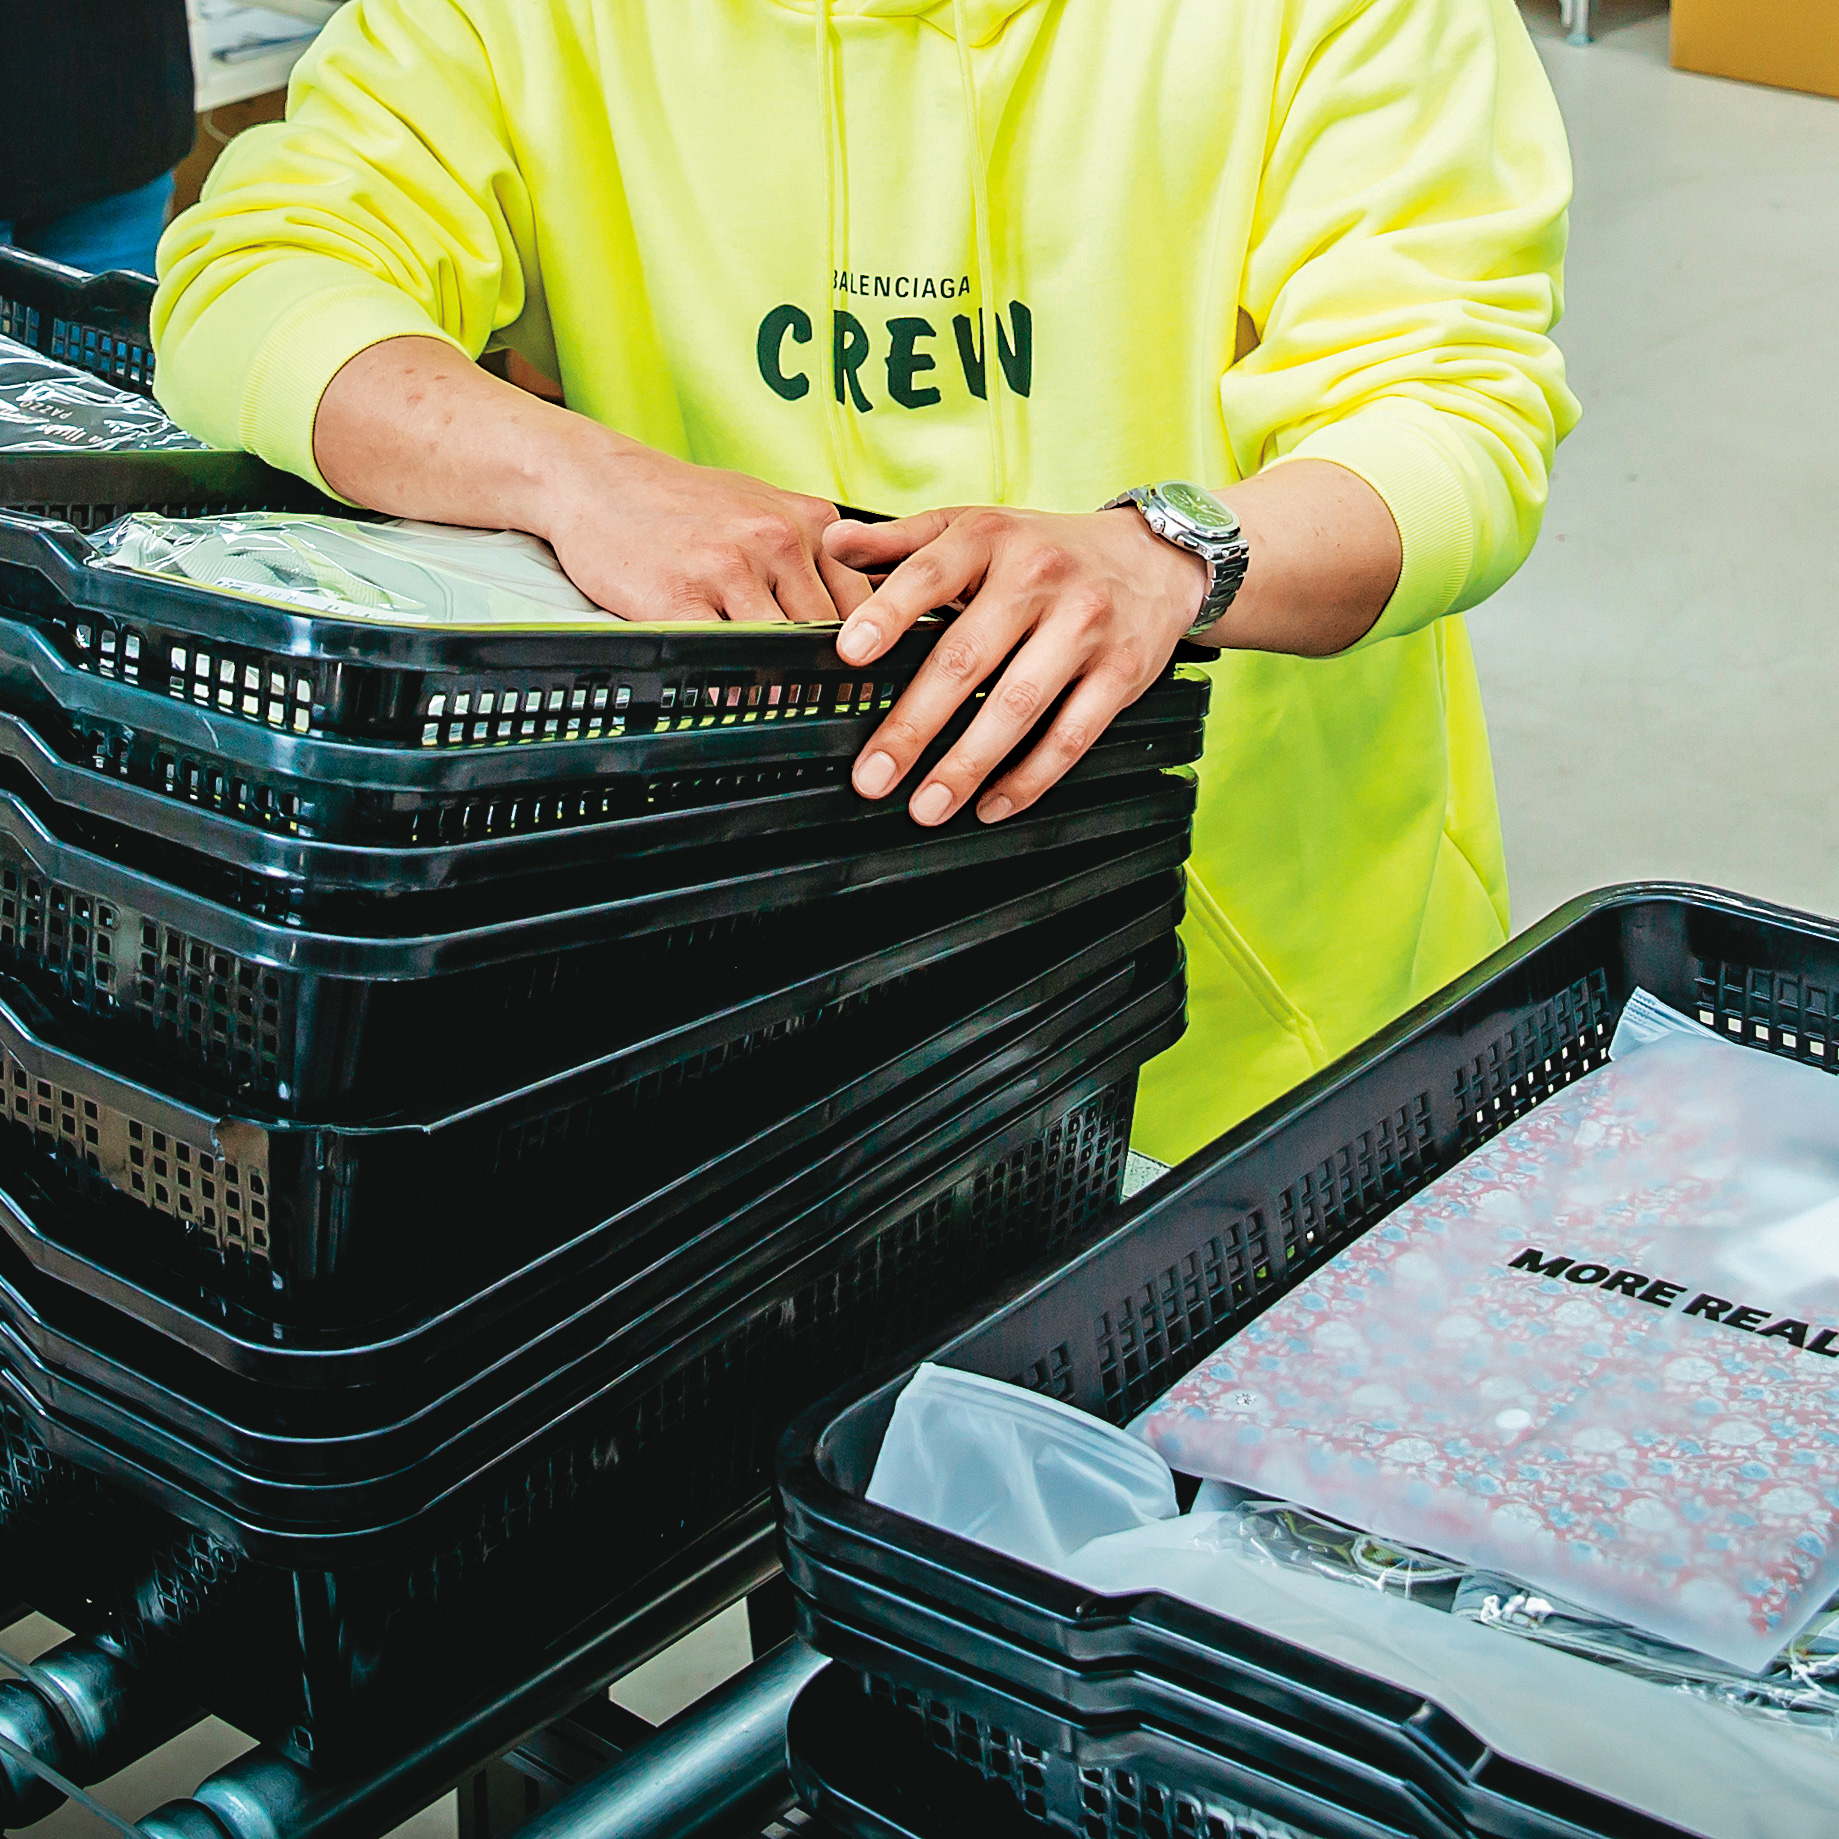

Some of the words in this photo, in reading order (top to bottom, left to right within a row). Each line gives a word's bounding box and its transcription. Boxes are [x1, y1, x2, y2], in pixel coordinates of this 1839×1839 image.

[757, 300, 1032, 413] CREW
[1507, 1247, 1688, 1308] MORE
[1682, 1292, 1839, 1358] REAL
